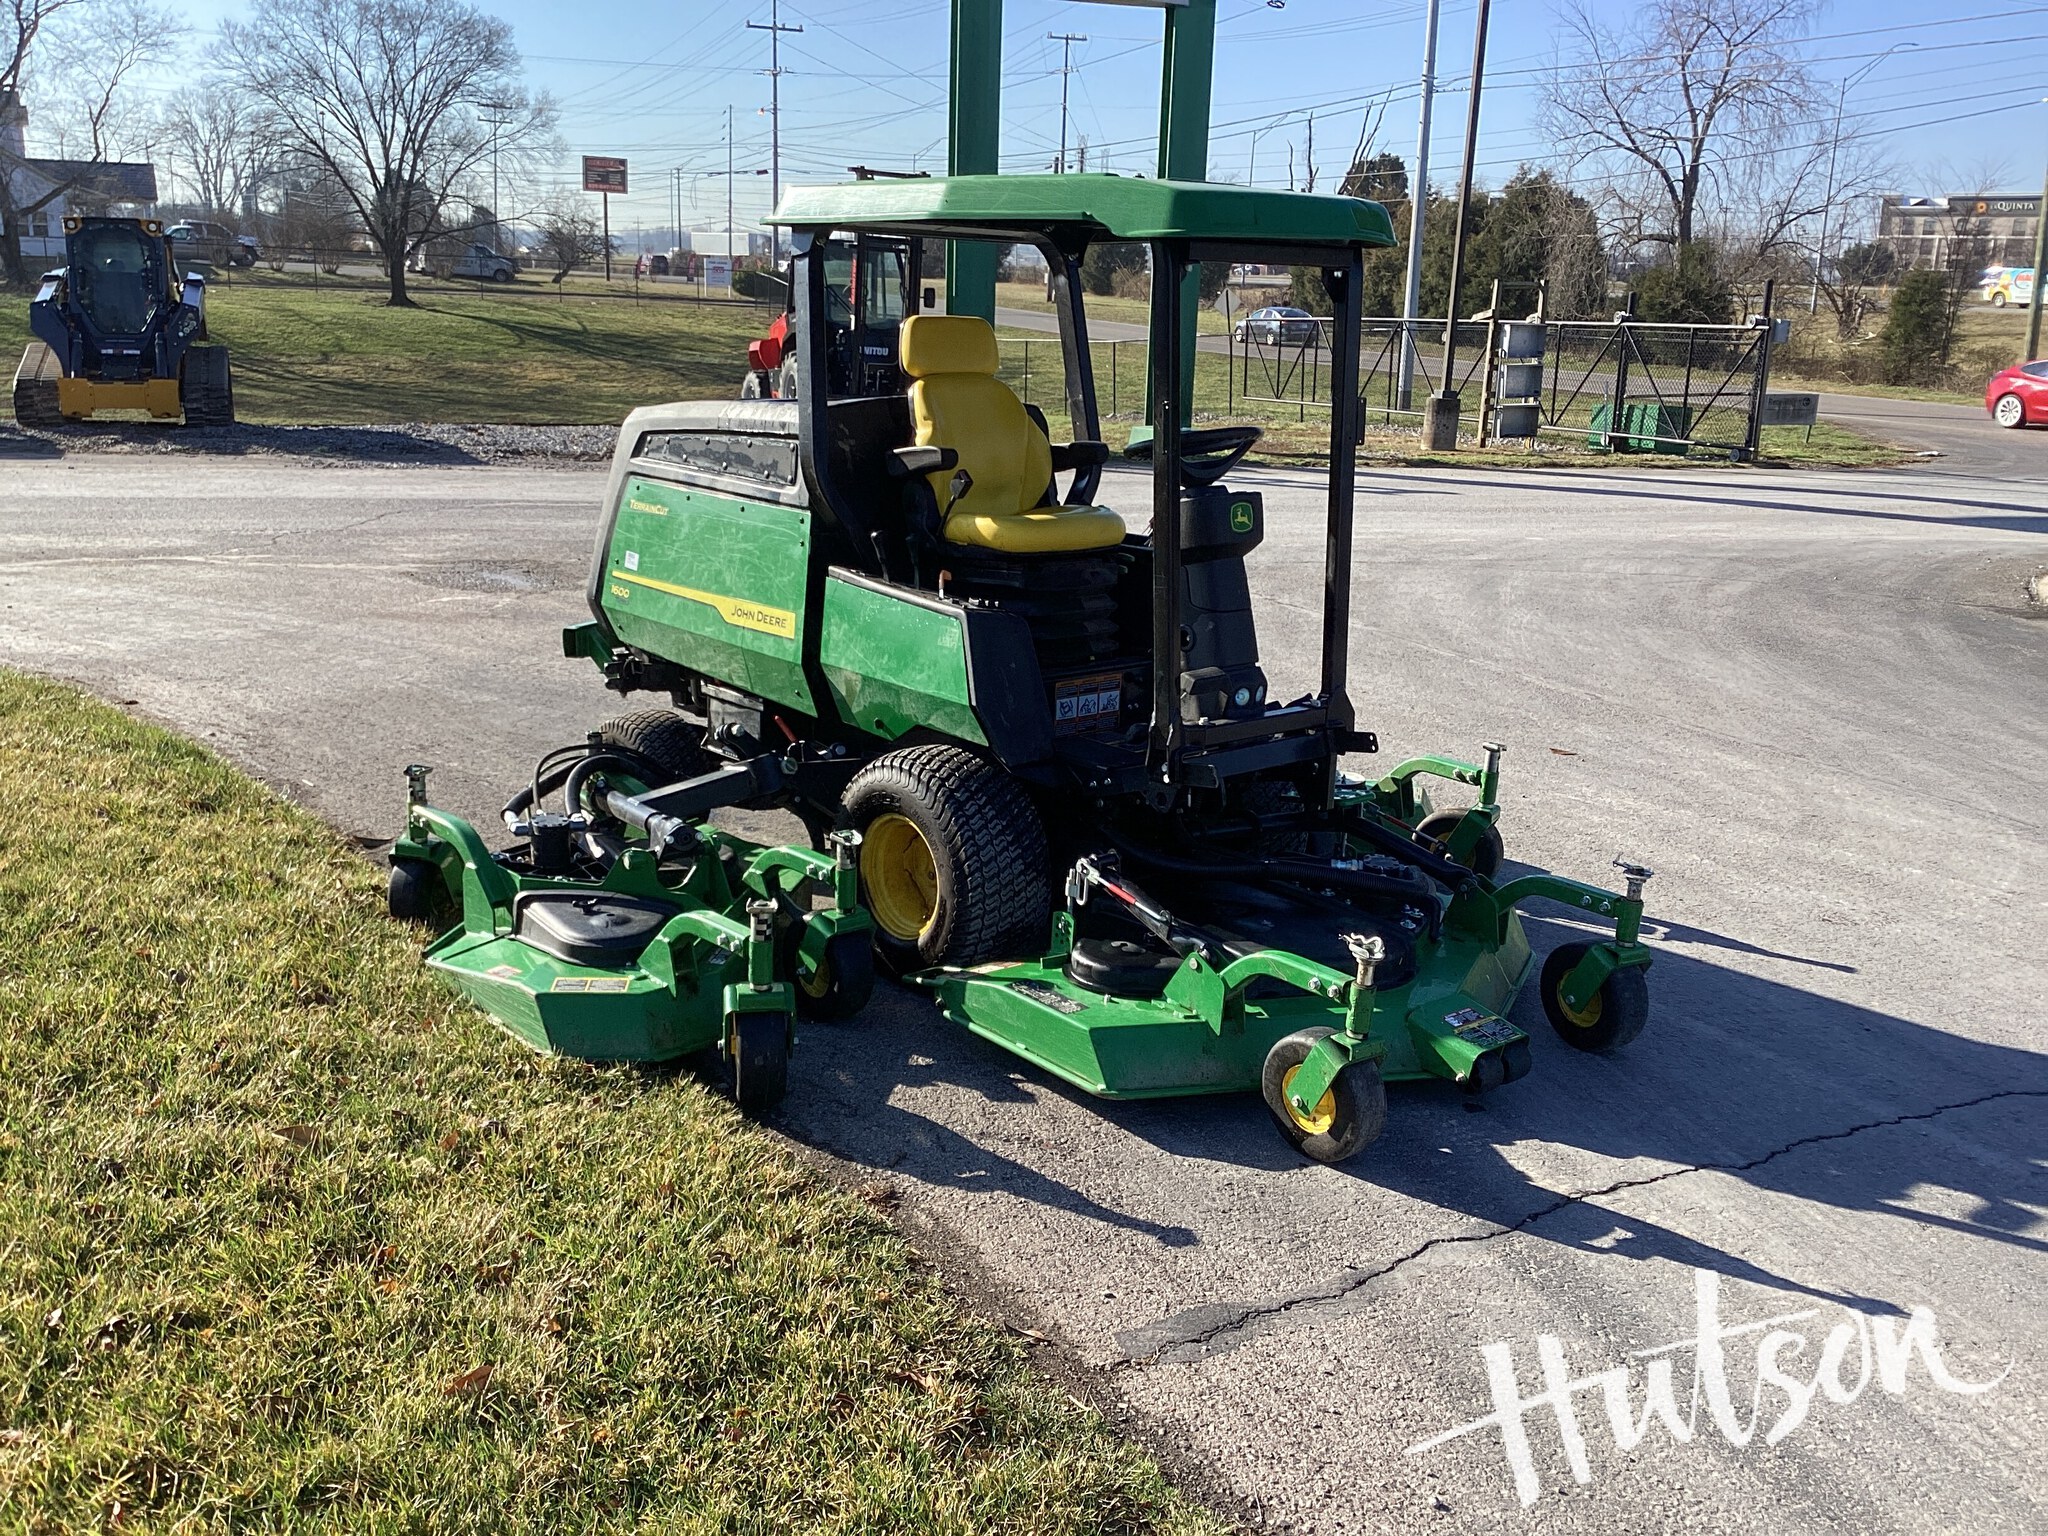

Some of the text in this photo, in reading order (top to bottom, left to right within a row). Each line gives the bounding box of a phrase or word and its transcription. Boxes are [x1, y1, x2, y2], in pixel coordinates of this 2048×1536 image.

[1997, 201, 2034, 211] QUINTA
[611, 585, 630, 598] 1600
[731, 605, 787, 628] JOHN DEERE
